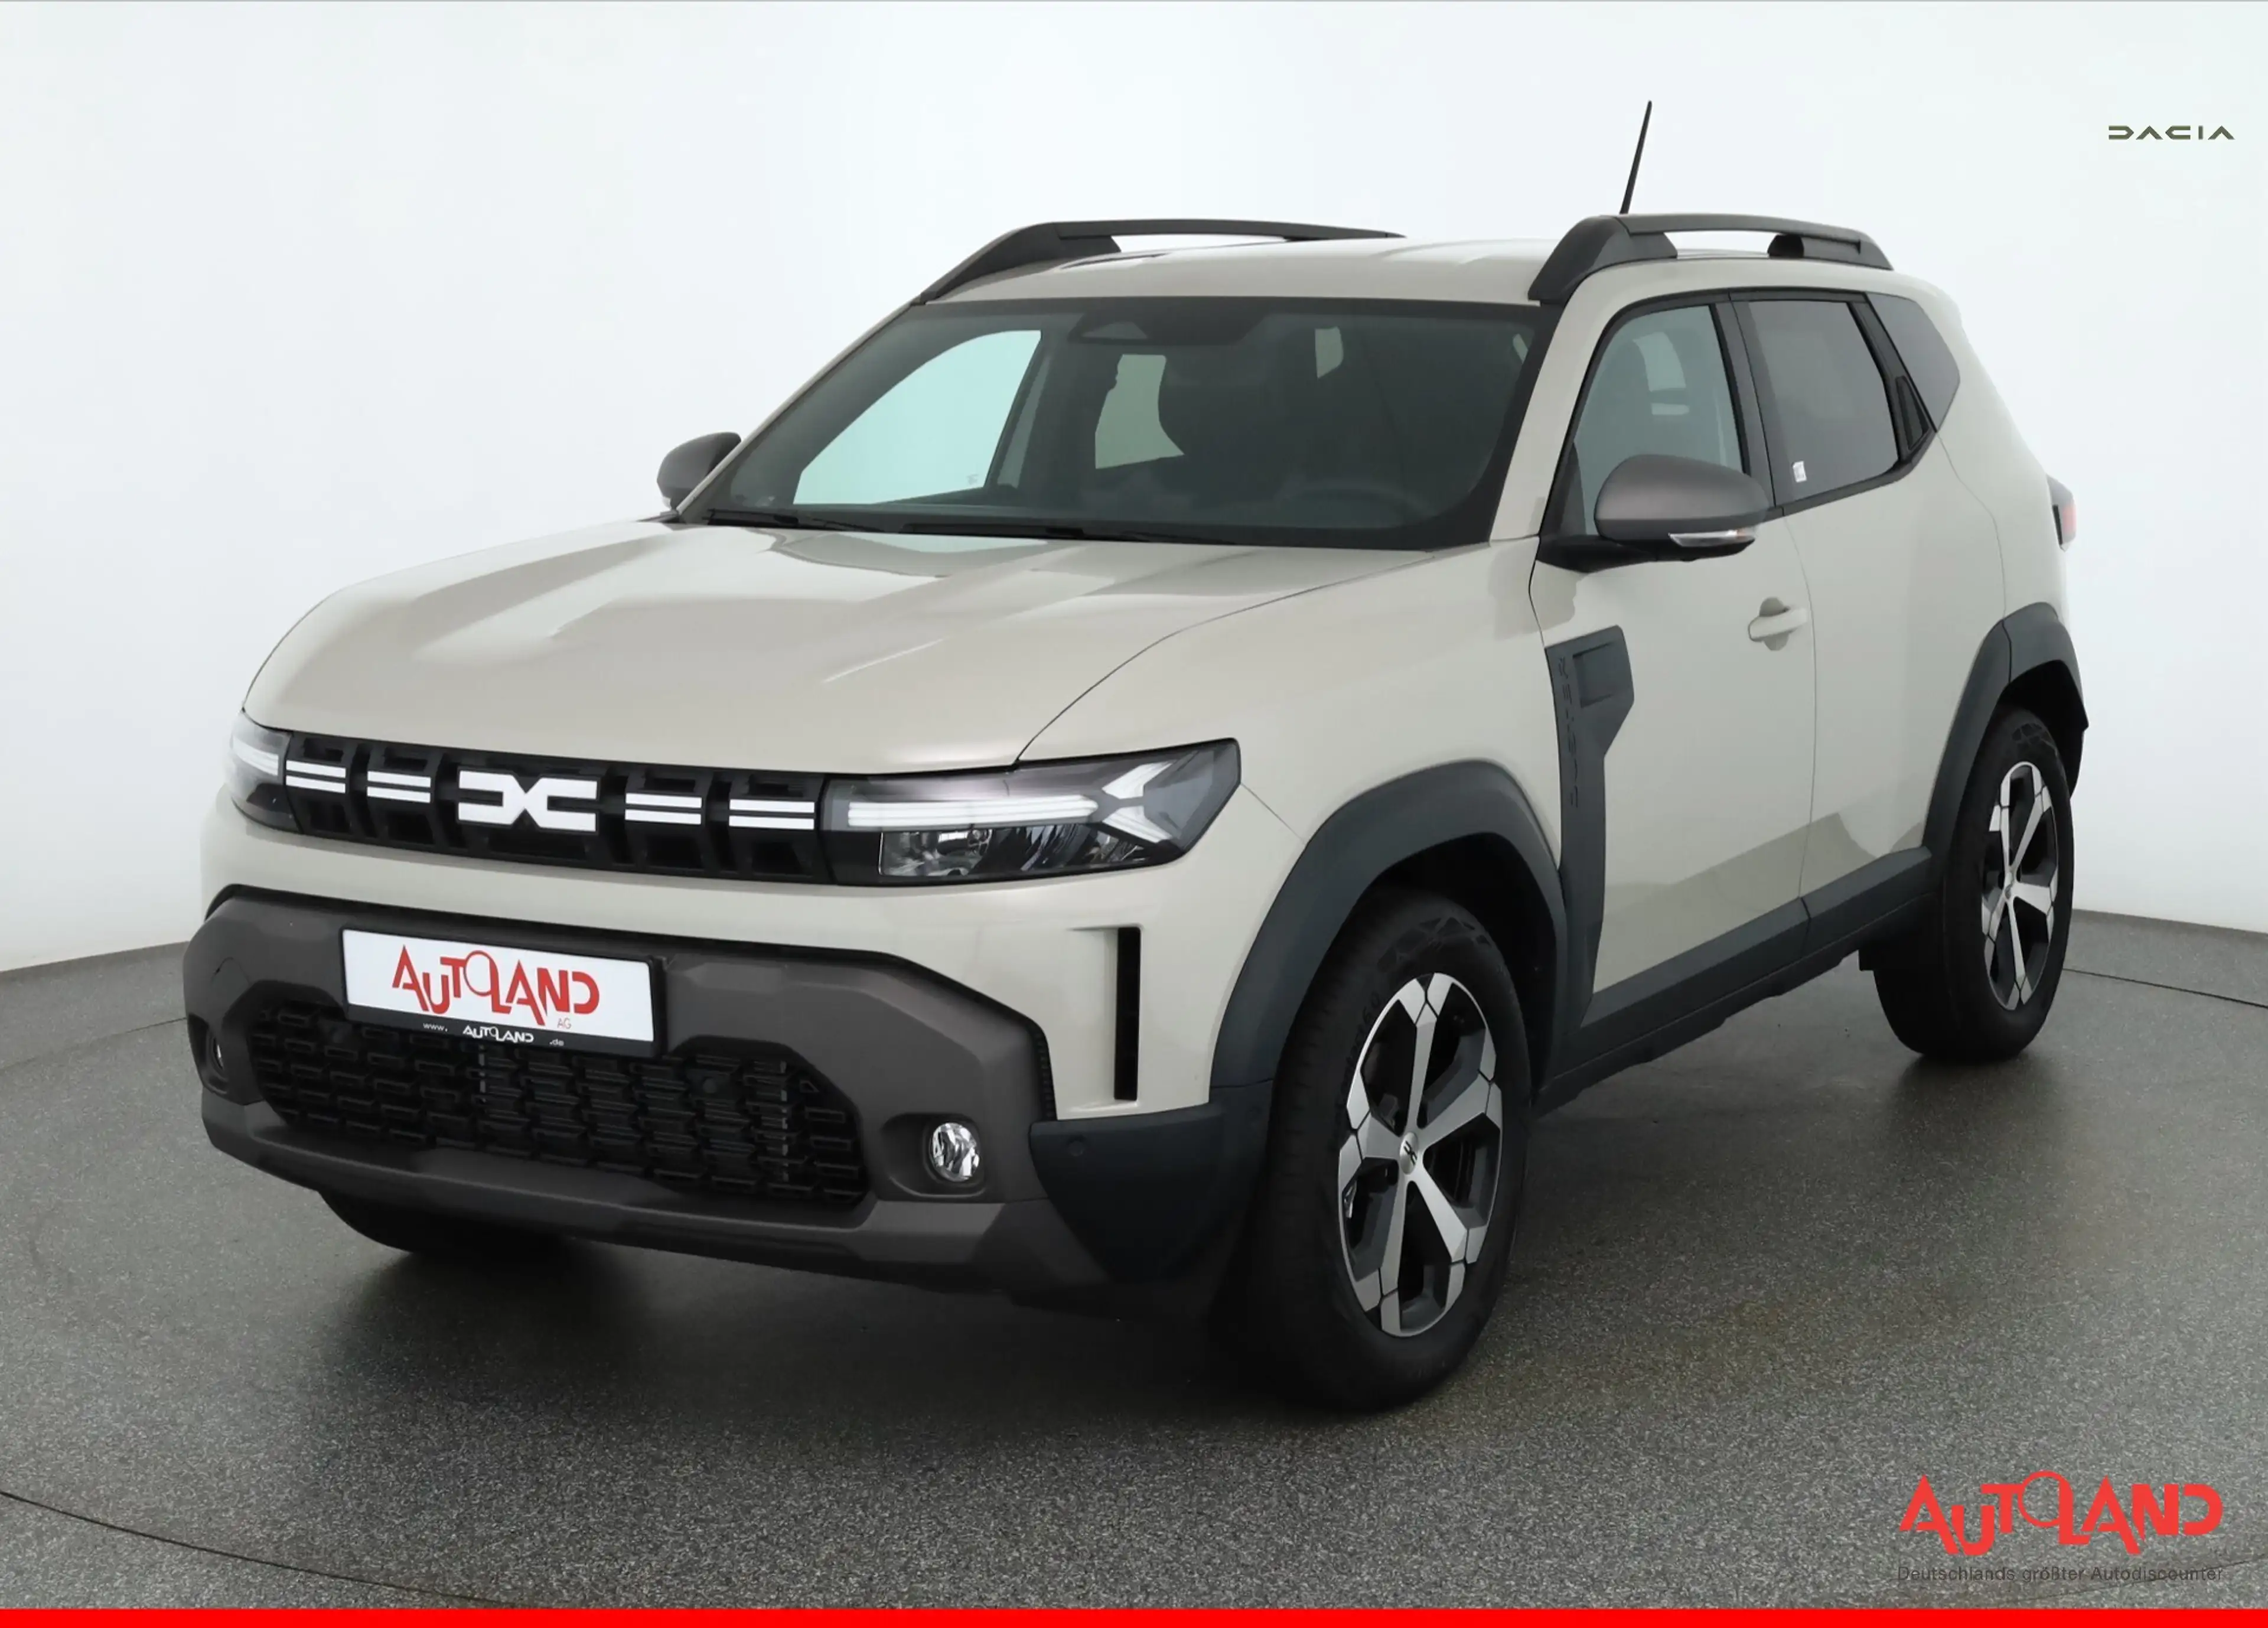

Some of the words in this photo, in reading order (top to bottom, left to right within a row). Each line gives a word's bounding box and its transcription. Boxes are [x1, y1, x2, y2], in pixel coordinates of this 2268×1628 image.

[393, 945, 600, 1025] AUTOLAND
[557, 1017, 572, 1030] AG
[462, 1025, 535, 1044] AUTOLAND
